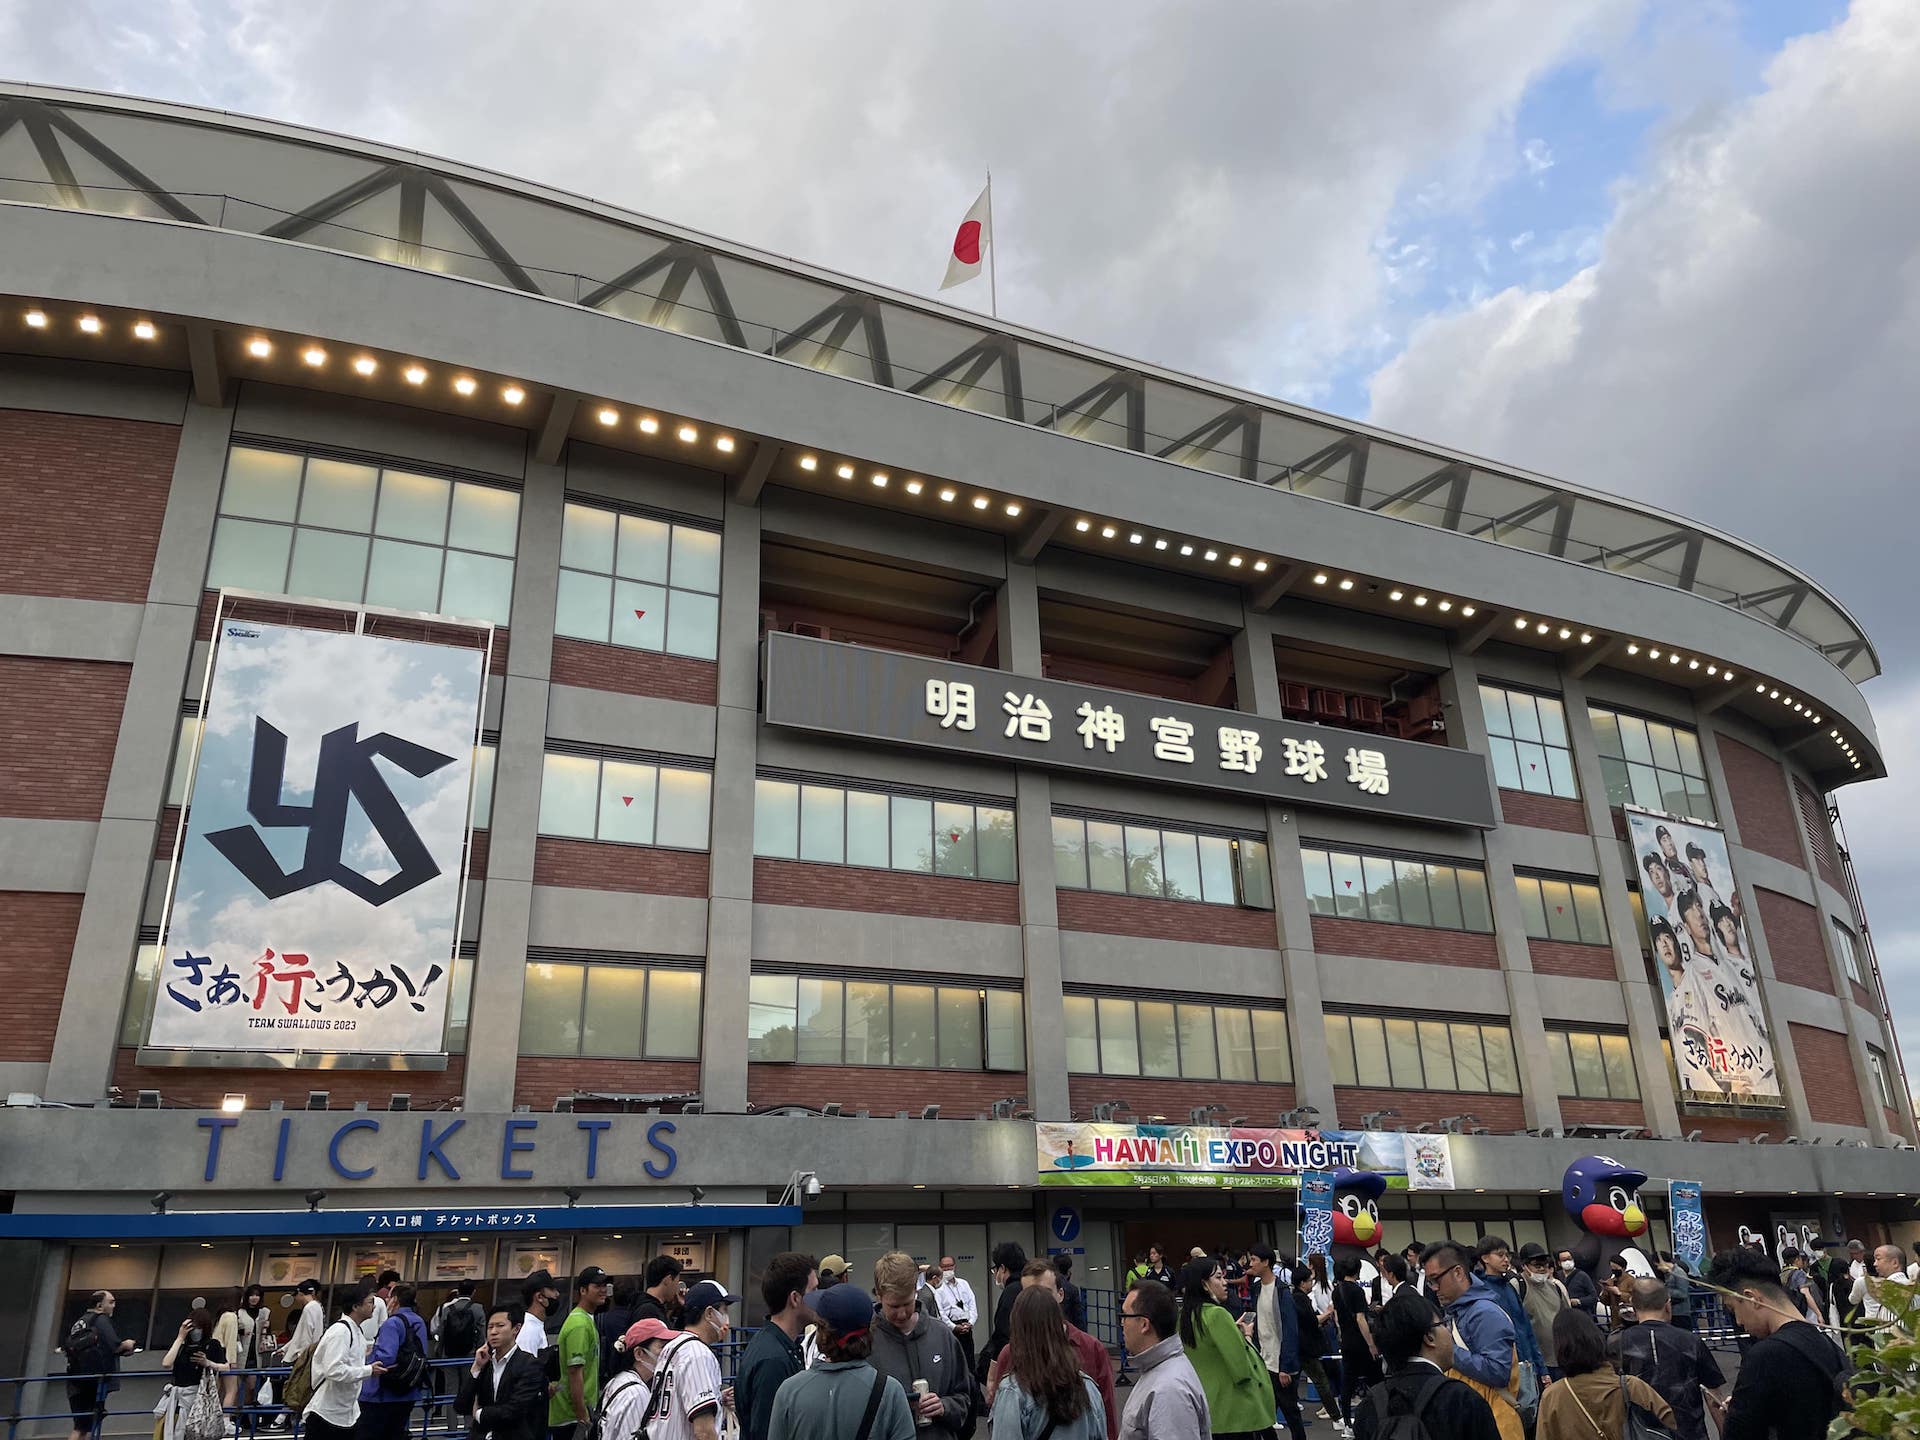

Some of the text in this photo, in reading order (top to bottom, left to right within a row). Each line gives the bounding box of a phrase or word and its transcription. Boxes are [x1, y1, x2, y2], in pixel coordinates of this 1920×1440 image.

[925, 678, 1390, 795] 明治神宮野球場
[248, 1018, 356, 1030] TEAM SWALLOWS 2023
[198, 1118, 677, 1182] TICKETS
[1208, 1140, 1275, 1166] EXPO
[1282, 1142, 1358, 1168] NIGHT
[367, 1213, 537, 1228] 7入口横 チケットボックス
[1060, 1214, 1073, 1236] 7
